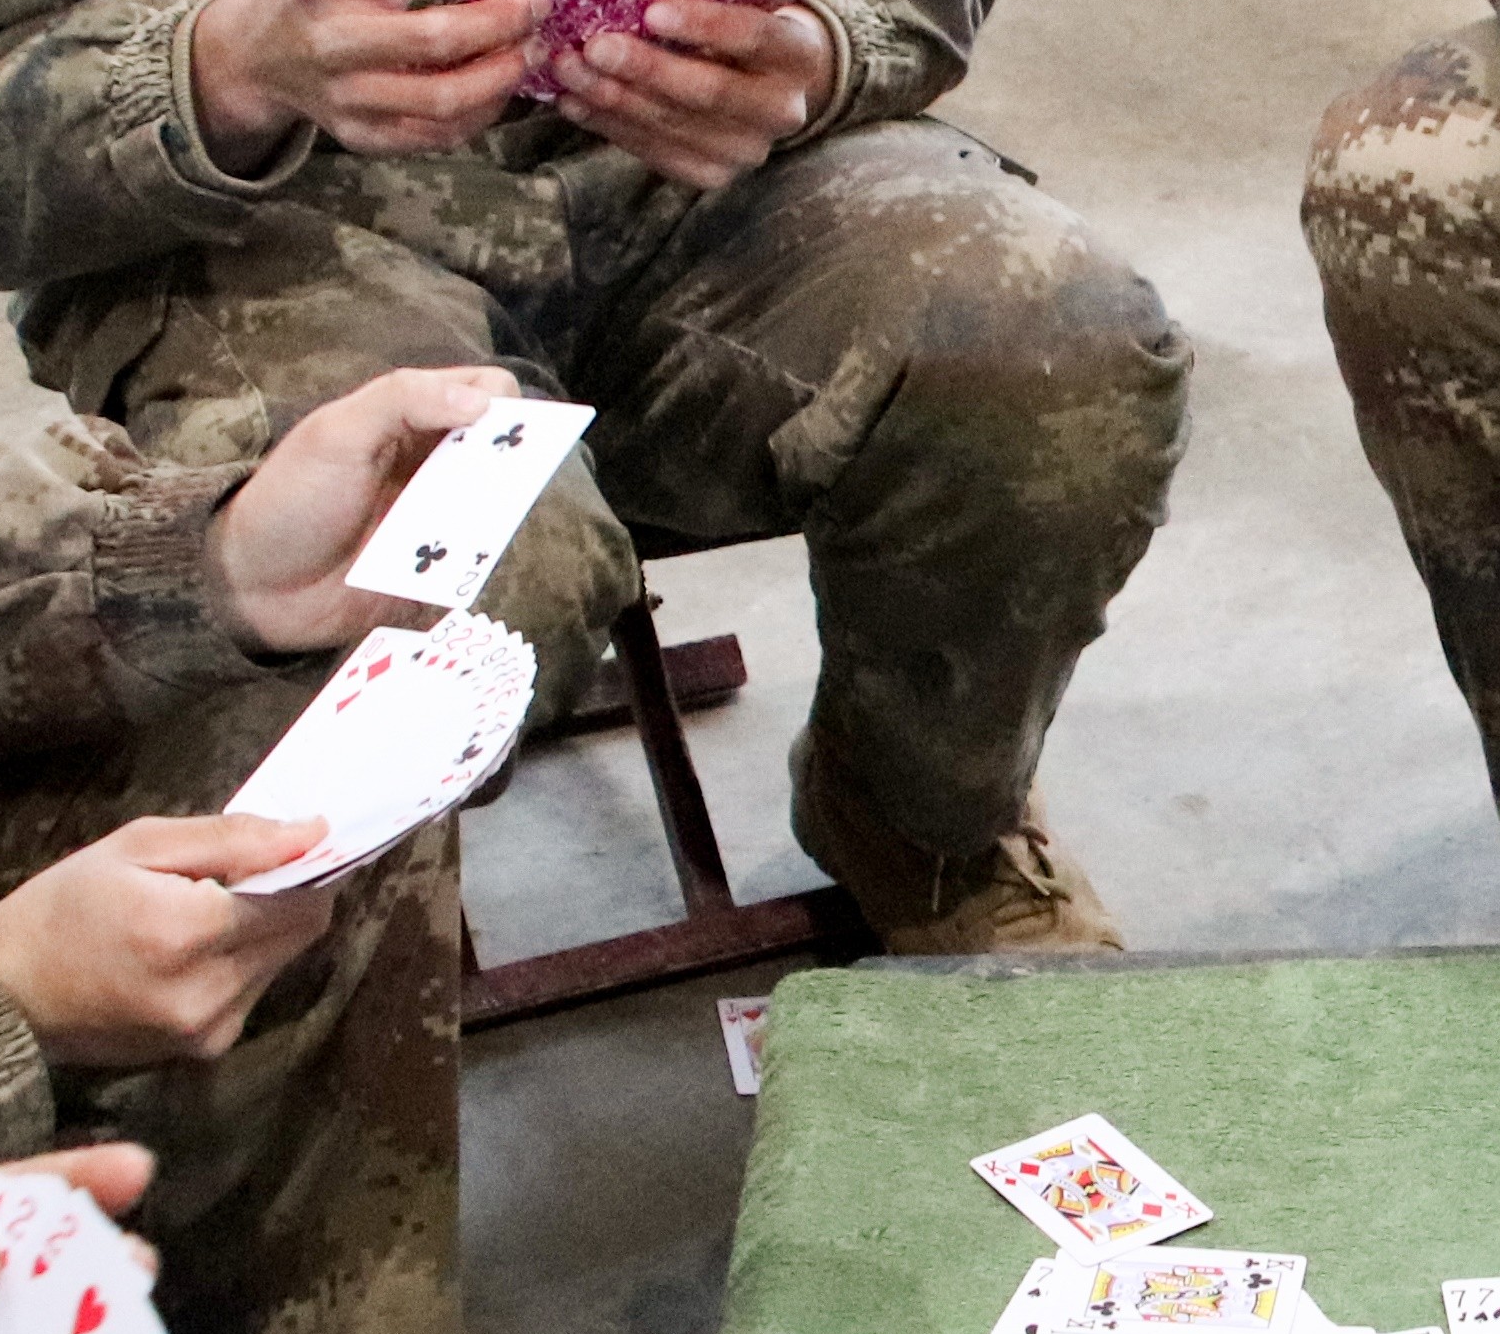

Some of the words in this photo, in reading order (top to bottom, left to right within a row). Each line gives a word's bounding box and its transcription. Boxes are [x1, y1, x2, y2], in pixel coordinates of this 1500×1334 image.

[457, 571, 479, 597] 2
[432, 620, 456, 644] 3
[446, 628, 472, 651] 2
[360, 637, 385, 659] 10
[466, 634, 492, 656] 2
[982, 1160, 1007, 1177] K
[1175, 1201, 1200, 1219] K
[1267, 1259, 1295, 1269] K
[1036, 1267, 1054, 1283] 7
[1450, 1290, 1467, 1308] 7
[1479, 1288, 1495, 1306] 7
[1066, 1318, 1096, 1329] K
